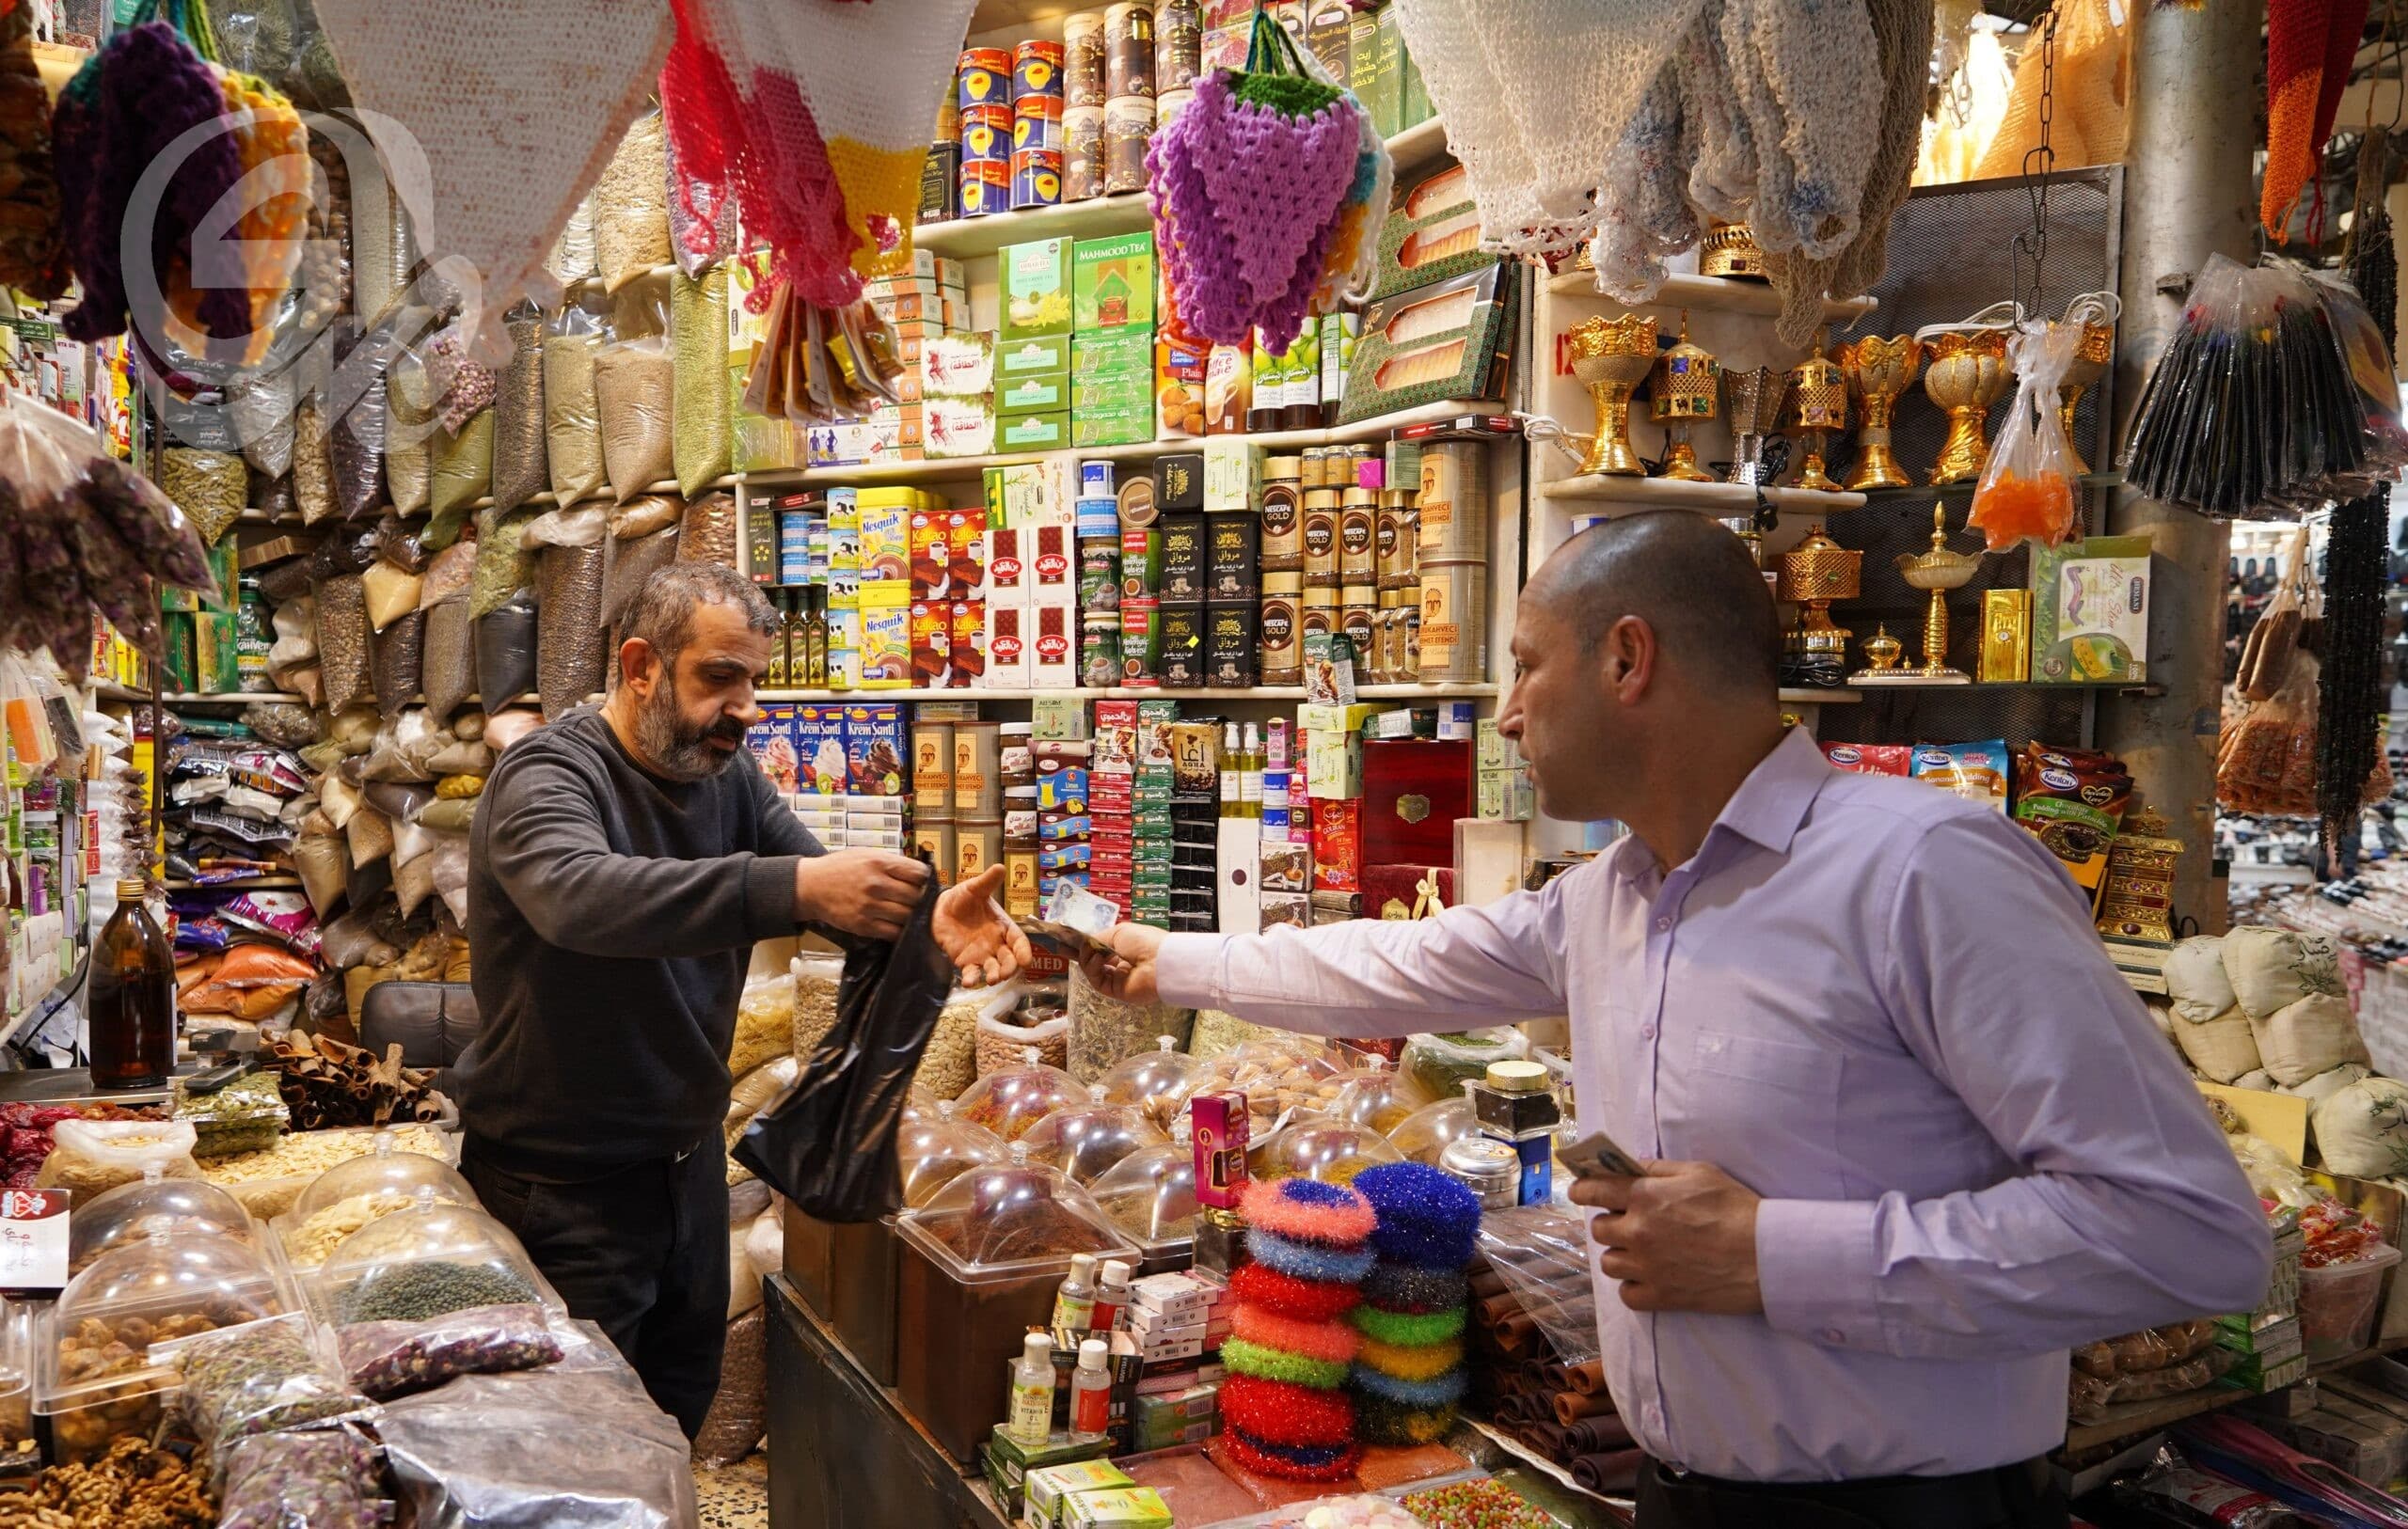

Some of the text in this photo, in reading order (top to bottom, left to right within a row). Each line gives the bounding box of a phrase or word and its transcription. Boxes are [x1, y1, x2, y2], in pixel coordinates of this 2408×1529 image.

[1080, 243, 1146, 260] MAHMOOD TEA
[1181, 368, 1202, 378] Plain
[1267, 512, 1290, 521] GOLD
[863, 513, 899, 534] Nesquik
[911, 530, 946, 543] Kakao
[950, 529, 984, 543] Kakao
[1308, 536, 1328, 544] GOLD
[1345, 533, 1364, 543] GOLD
[1169, 552, 1190, 564] مرواني
[1217, 550, 1240, 563] مرواني
[866, 613, 904, 633] Nesquik
[912, 620, 947, 631] Kakao
[1265, 626, 1287, 635] GOLD
[1217, 638, 1240, 650] مرواني
[748, 723, 769, 735] Krem
[800, 721, 820, 734] Krem
[848, 722, 872, 735] Krem
[1834, 750, 1859, 760] Kenton
[2044, 772, 2073, 786] Kenton
[2034, 804, 2059, 814] Pudding
[2055, 801, 2088, 812] Chocolate
